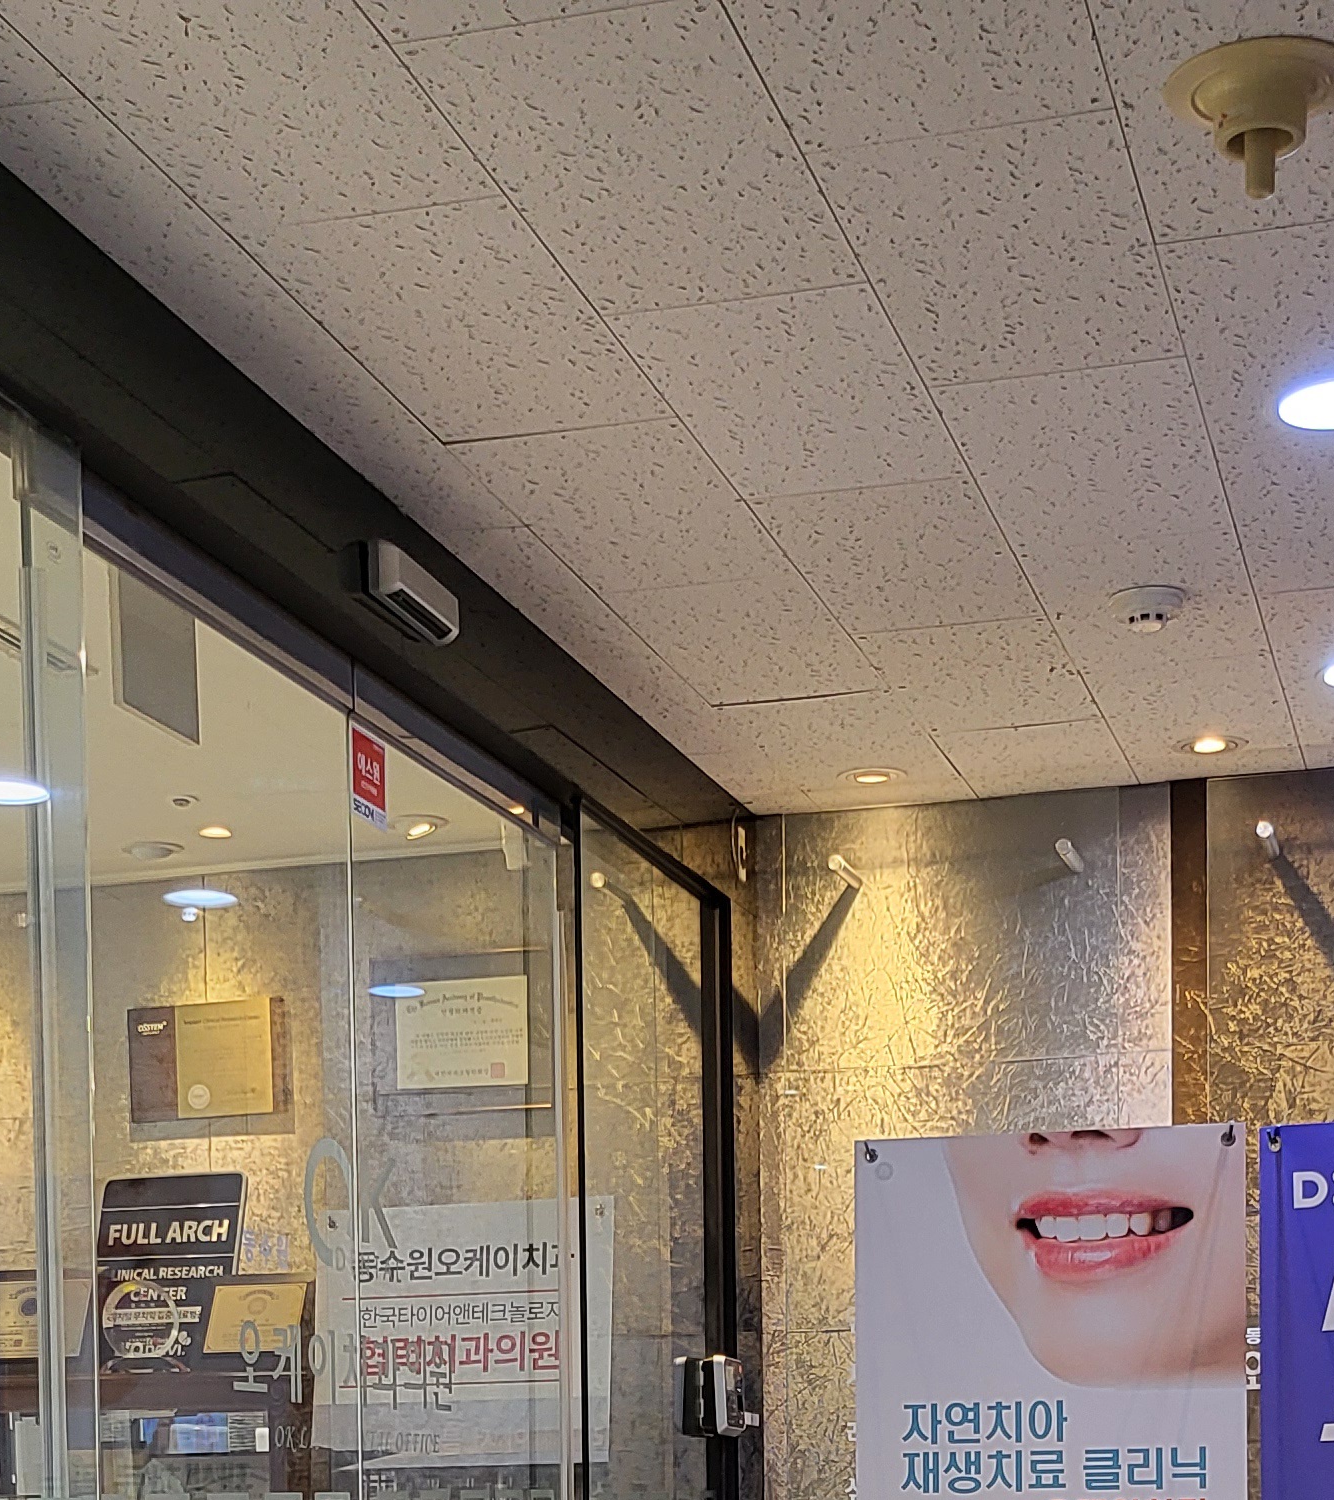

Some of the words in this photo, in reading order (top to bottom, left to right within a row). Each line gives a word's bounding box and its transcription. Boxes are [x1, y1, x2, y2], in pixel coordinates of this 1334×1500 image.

[108, 1222, 162, 1246] FULL
[166, 1219, 230, 1244] ARCH
[110, 1267, 157, 1282] LINICAL
[159, 1265, 223, 1279] RESEARCH
[901, 1399, 1068, 1445] 자연치아
[901, 1448, 1068, 1494] 재생치료
[1083, 1446, 1208, 1491] 클리닉
